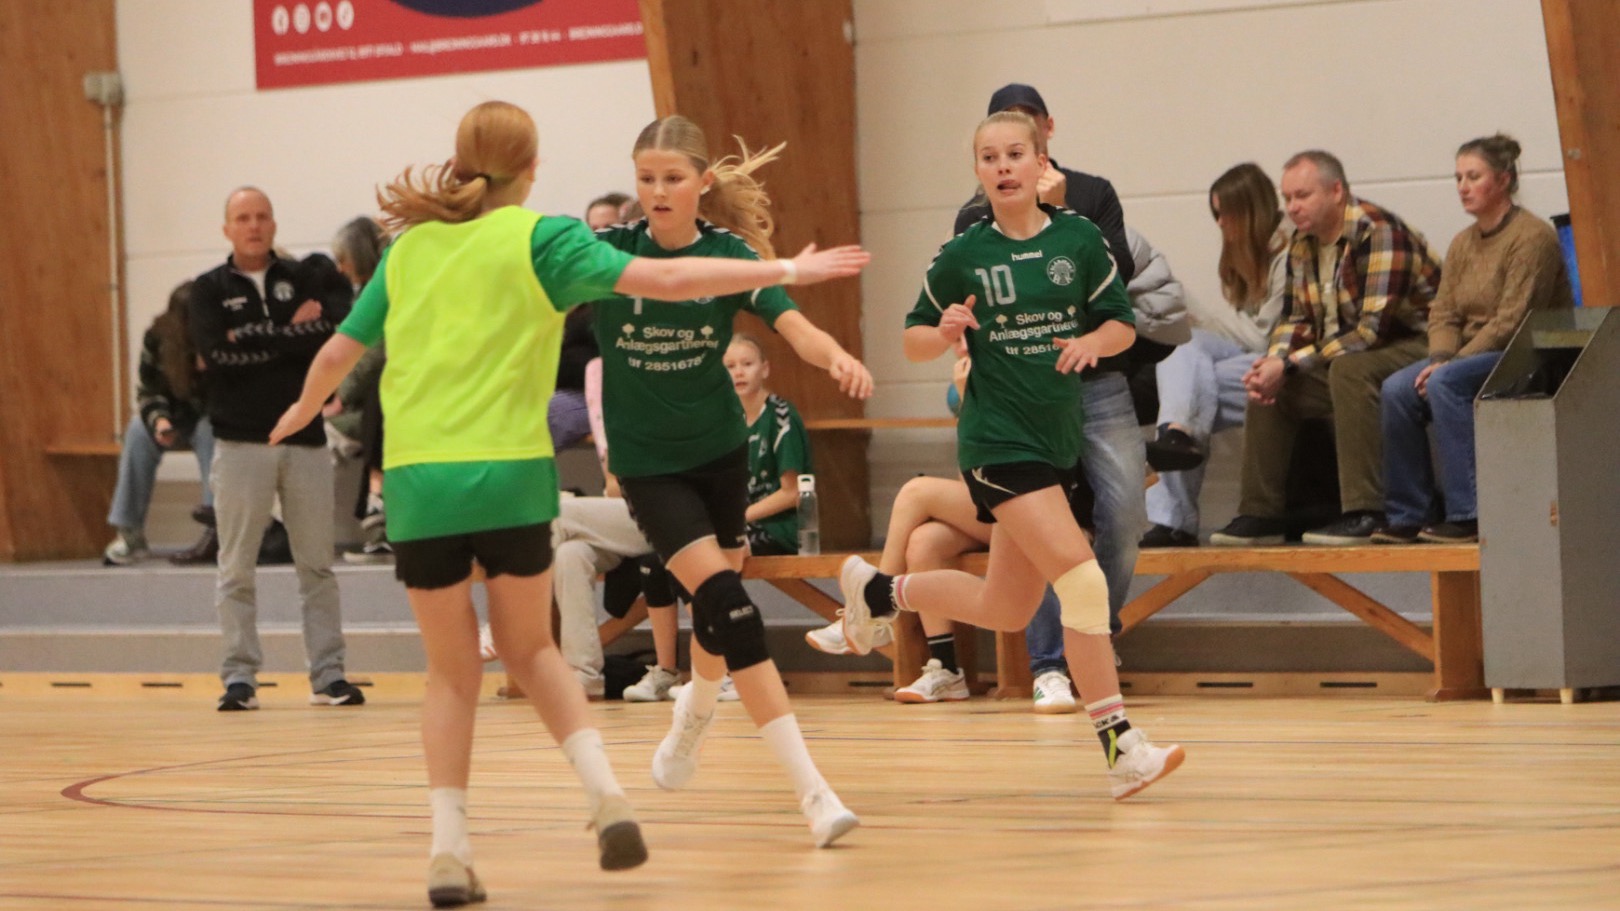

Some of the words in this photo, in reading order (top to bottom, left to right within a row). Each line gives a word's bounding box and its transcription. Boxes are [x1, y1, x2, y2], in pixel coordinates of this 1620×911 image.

[1011, 249, 1043, 262] hummel
[974, 264, 1017, 307] 10
[1015, 312, 1045, 326] Skov
[1047, 311, 1063, 323] og
[642, 326, 674, 339] Skov
[677, 329, 695, 342] og
[1005, 345, 1019, 355] tlf
[1023, 344, 1060, 355] 28516
[644, 352, 706, 372] 2851678
